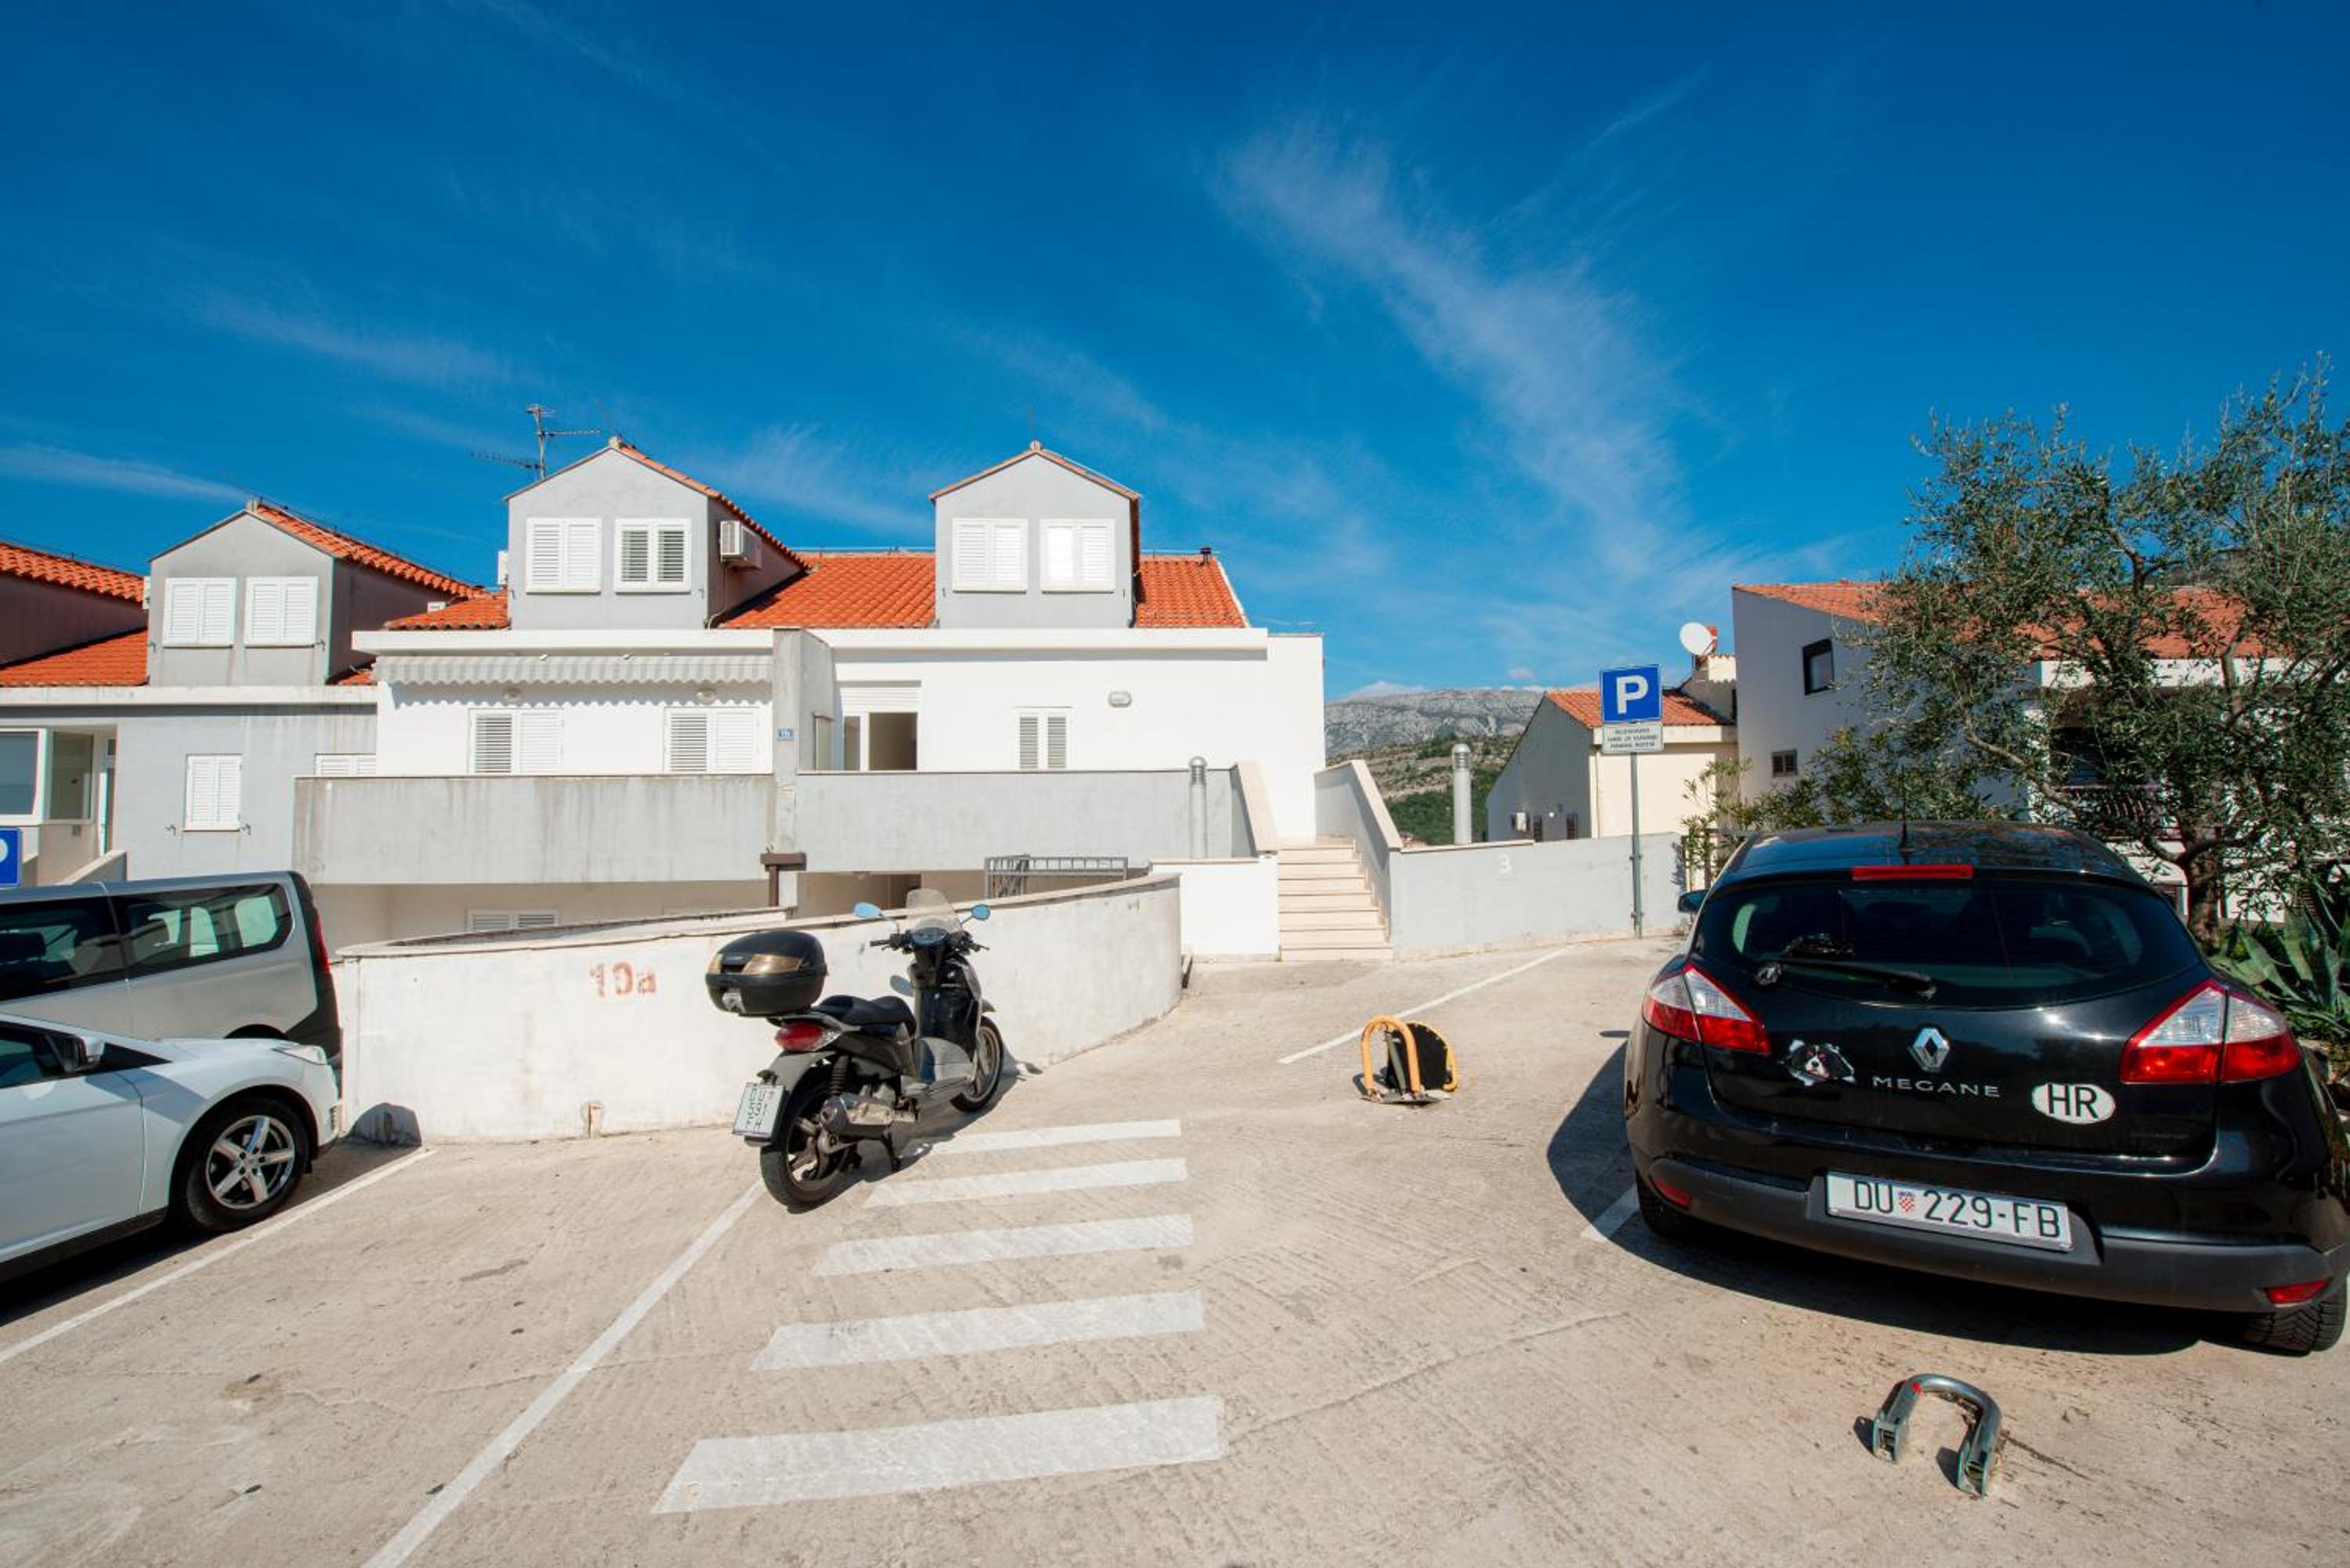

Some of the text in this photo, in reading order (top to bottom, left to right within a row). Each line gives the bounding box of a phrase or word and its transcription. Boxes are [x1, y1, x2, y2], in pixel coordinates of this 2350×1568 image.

[1616, 674, 1649, 715] P
[1497, 854, 1513, 873] 3
[1872, 1076, 2000, 1097] MEGANE
[2047, 1082, 2099, 1119] HR
[1854, 1180, 2061, 1238] DU 229-FB
